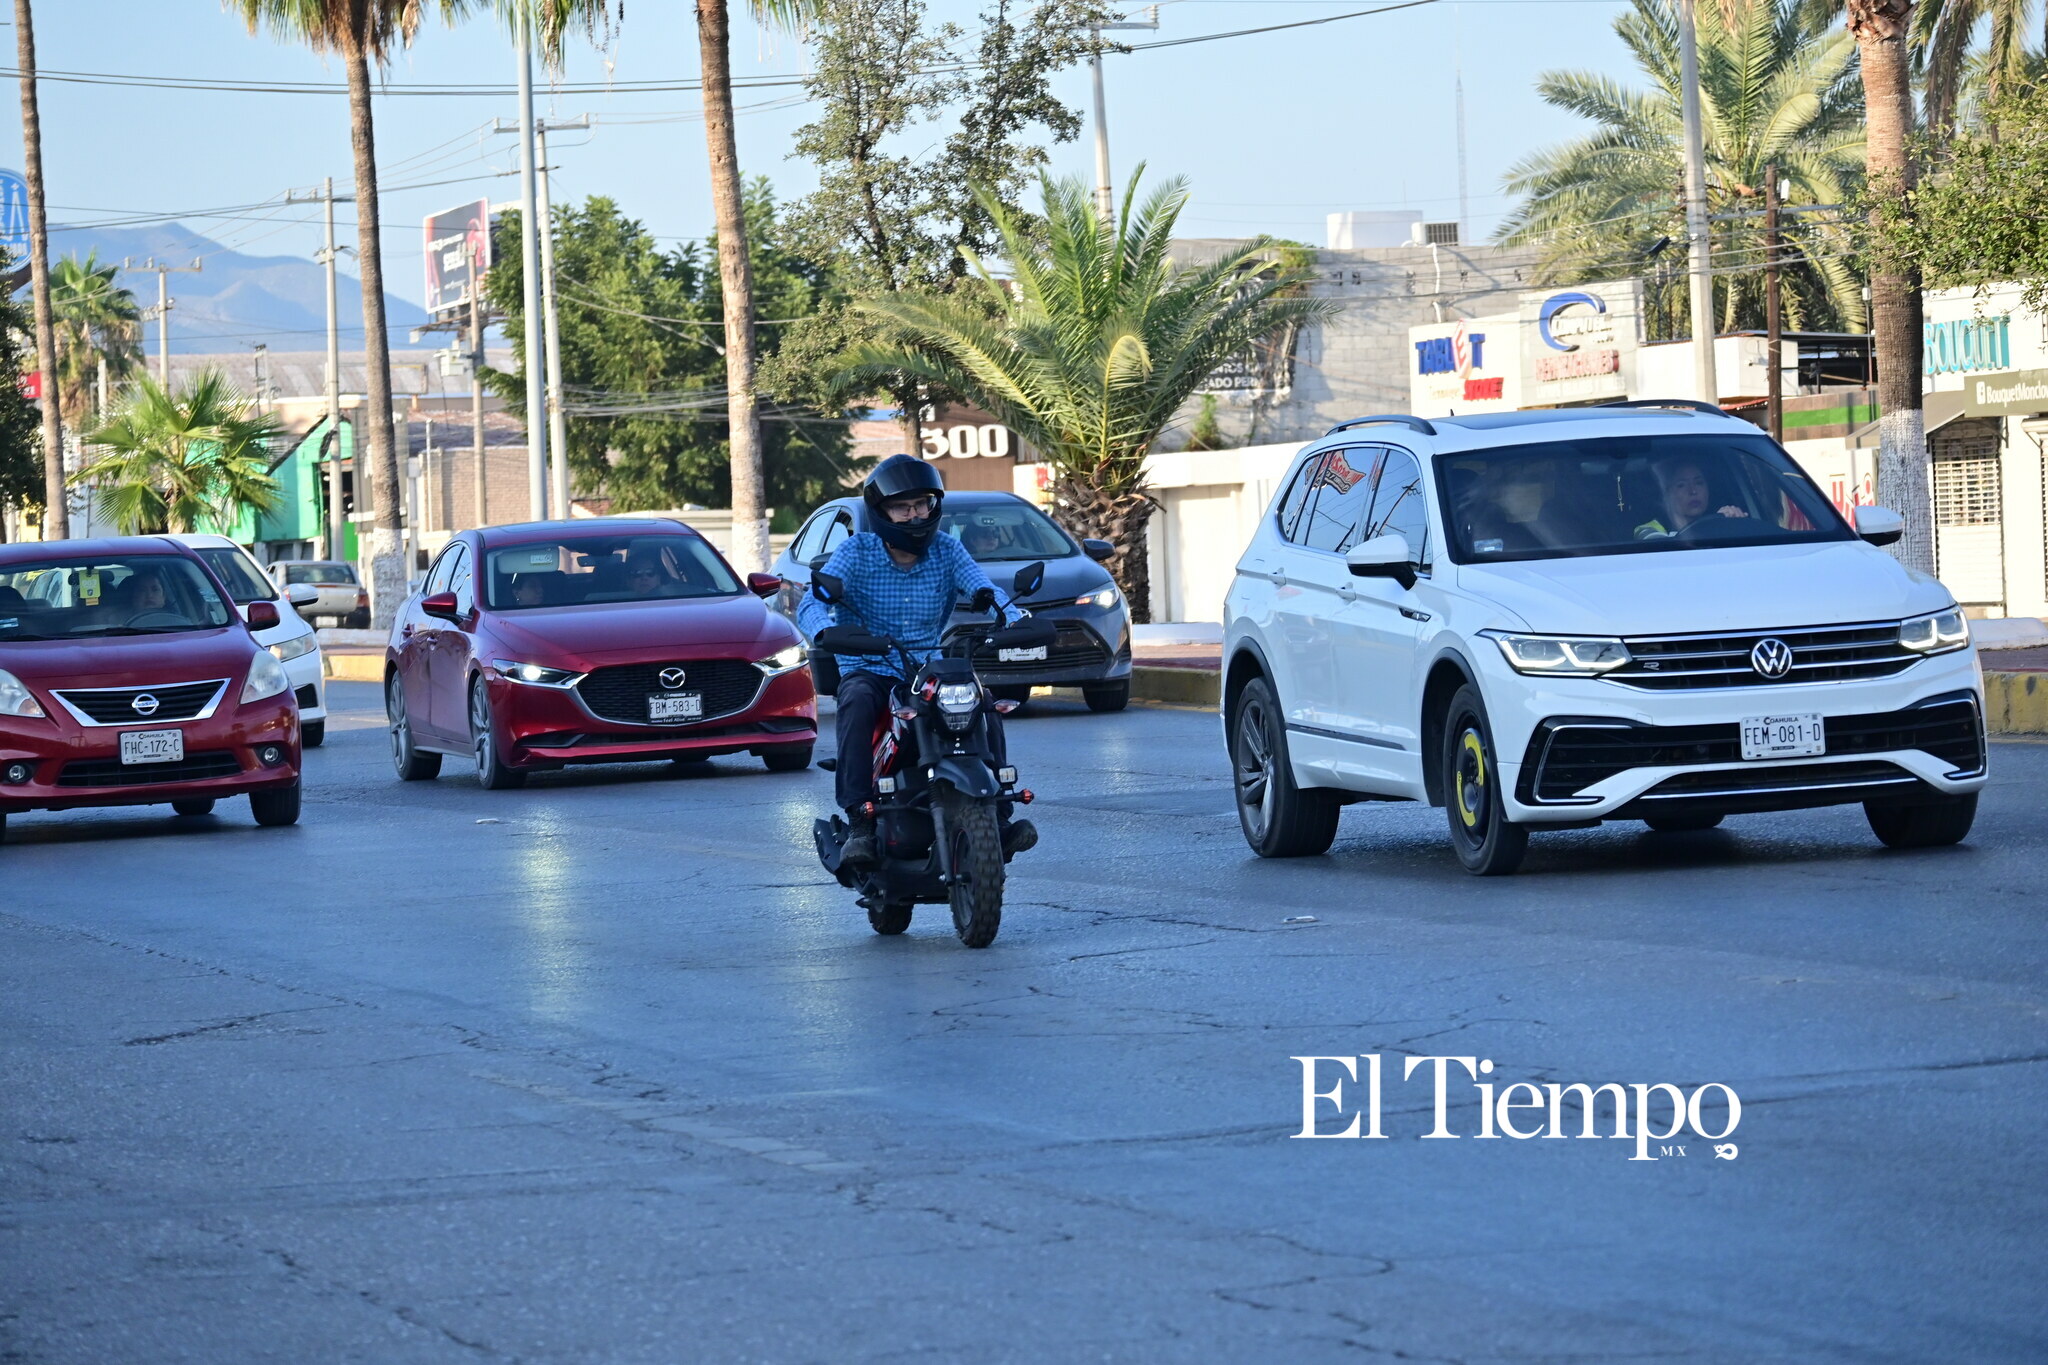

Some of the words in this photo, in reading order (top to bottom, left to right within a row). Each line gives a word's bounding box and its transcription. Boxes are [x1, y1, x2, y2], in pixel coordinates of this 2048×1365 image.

[1415, 328, 1485, 376] TABLET
[1923, 315, 2011, 376] BOUQUET
[1462, 377, 1504, 401] STORE
[1986, 379, 2048, 408] BouquetMonclo
[920, 424, 1009, 460] 300
[649, 699, 701, 715] FBM-583-D
[1763, 715, 1799, 726] COAHUILA
[1744, 722, 1821, 746] FEM-081-D
[124, 738, 180, 755] FHC-172-C
